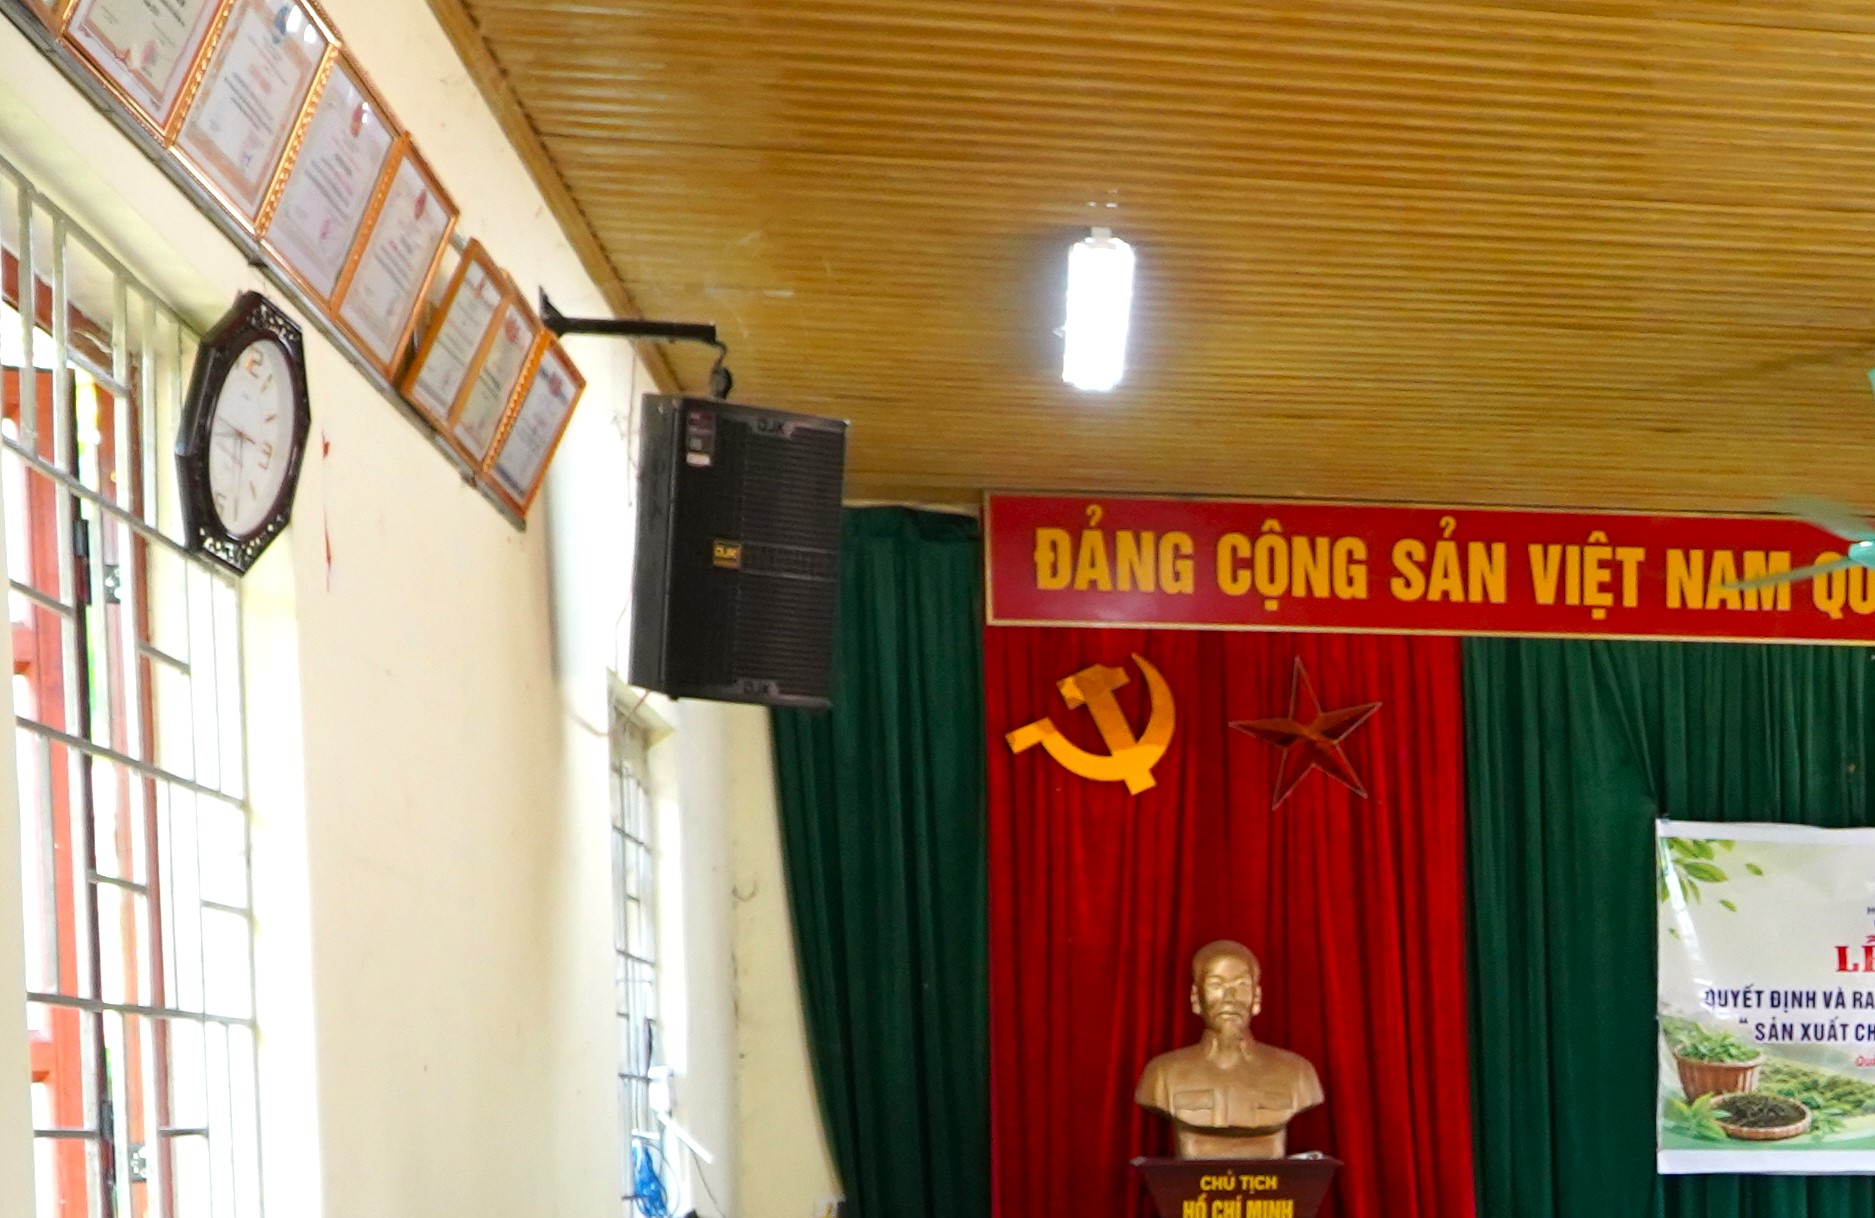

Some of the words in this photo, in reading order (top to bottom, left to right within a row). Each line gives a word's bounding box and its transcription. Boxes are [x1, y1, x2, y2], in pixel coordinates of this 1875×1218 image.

[1034, 505, 1195, 593] ĐẢNG
[1217, 520, 1369, 611] CỘNG
[1391, 516, 1506, 604] SẢN
[1529, 531, 1646, 620] VIỆT
[1666, 548, 1791, 611] NAM
[1704, 983, 1765, 1009] QUYẾT
[1769, 989, 1817, 1013] ĐỊNH
[1823, 986, 1847, 1010] VÀ
[1852, 990, 1875, 1010] RA
[1755, 1017, 1794, 1042] SẢN
[1800, 1016, 1849, 1042] XUẤT
[1200, 1169, 1236, 1191] CHỦ
[1239, 1174, 1279, 1194] TỊCH
